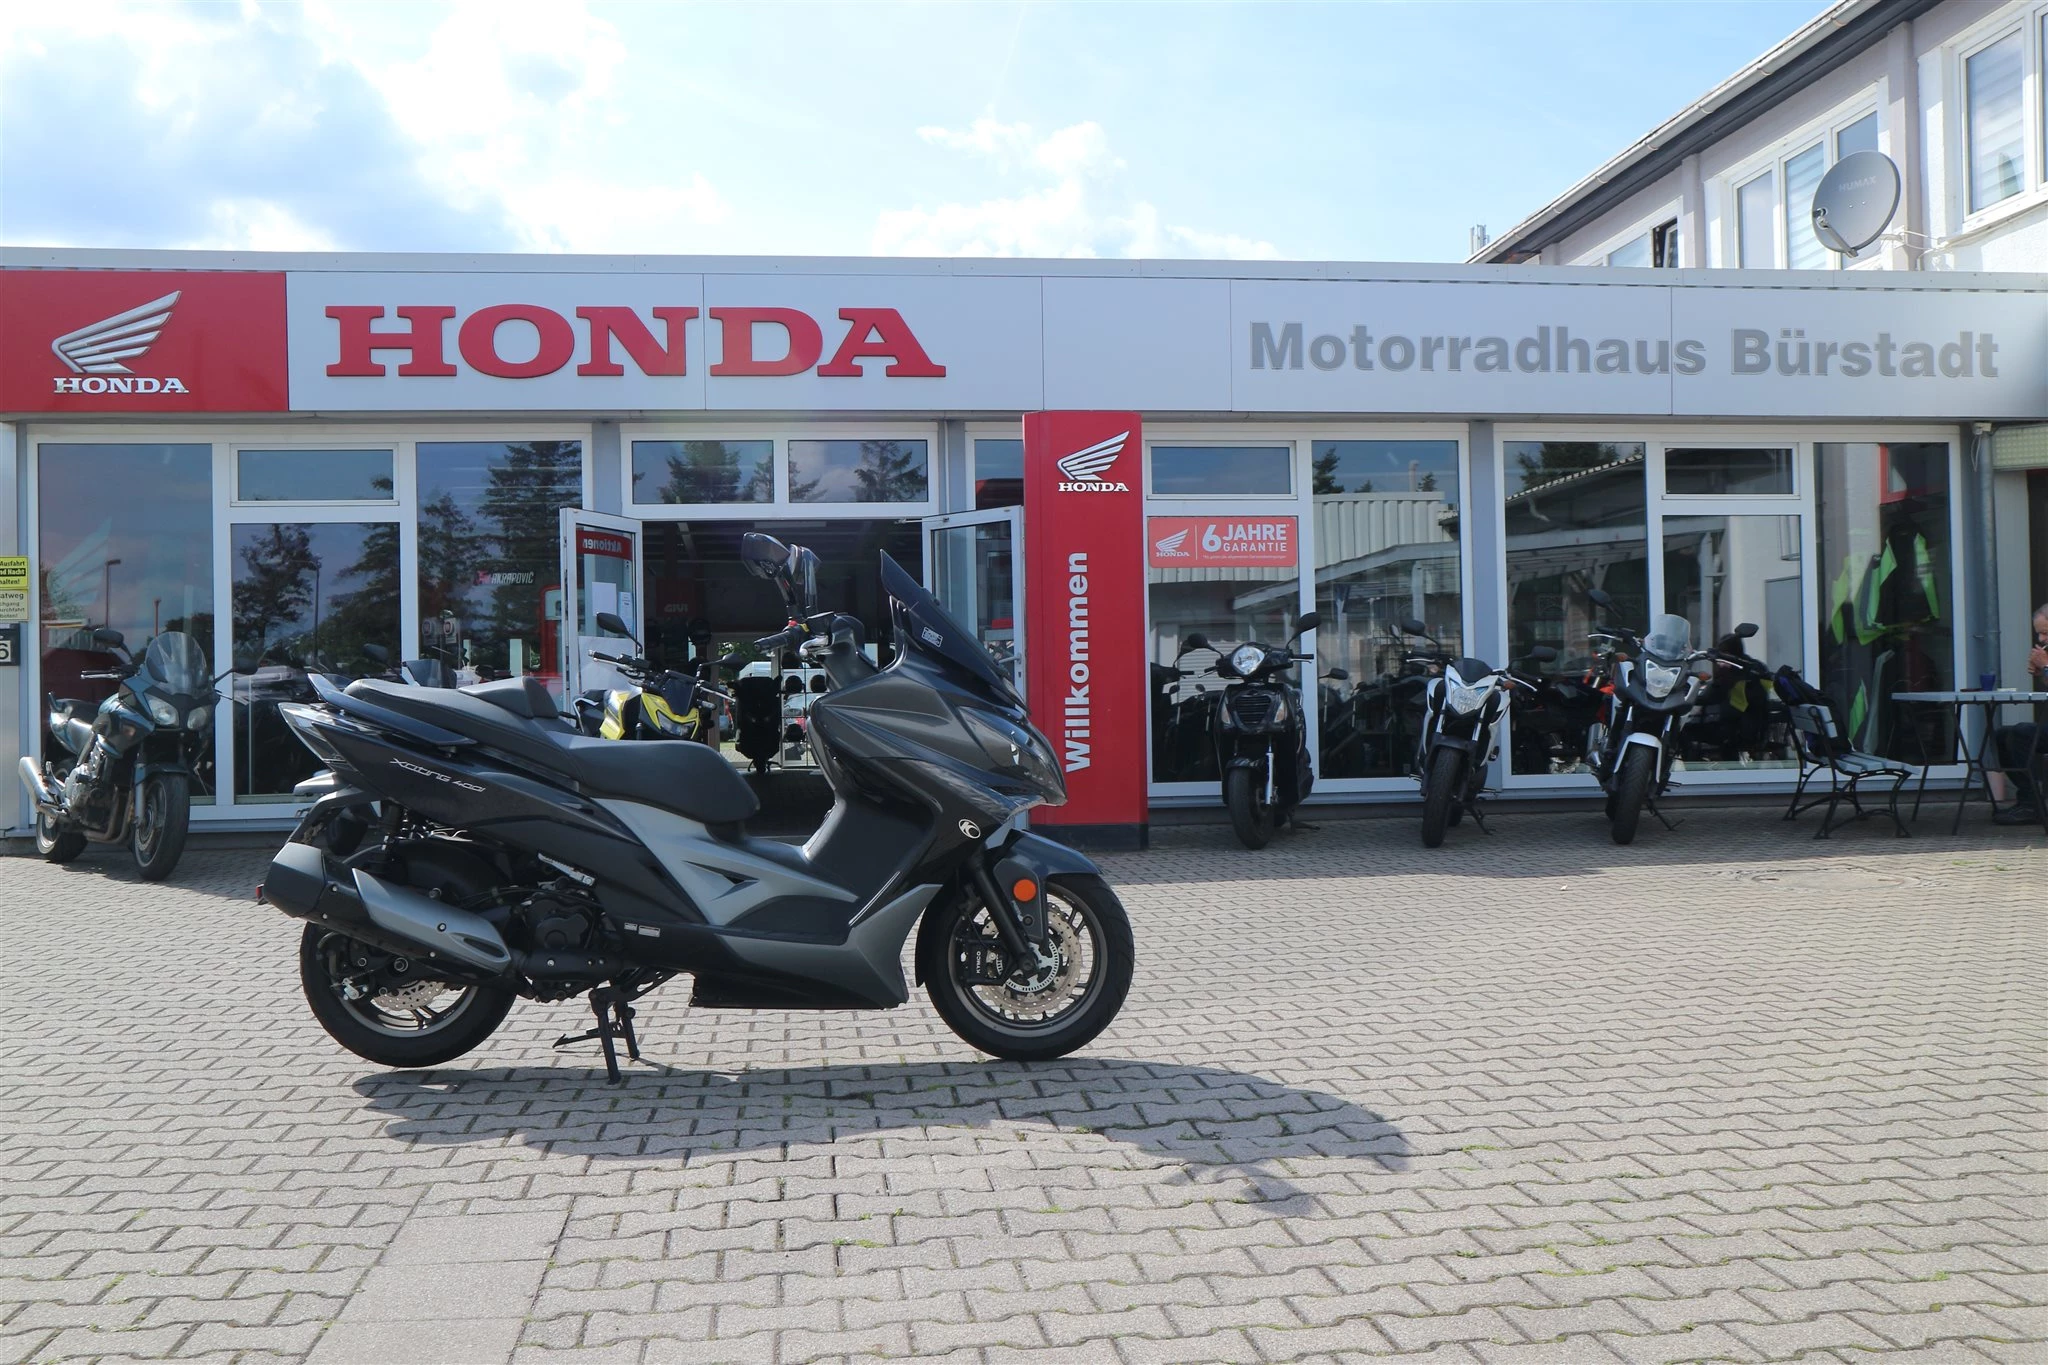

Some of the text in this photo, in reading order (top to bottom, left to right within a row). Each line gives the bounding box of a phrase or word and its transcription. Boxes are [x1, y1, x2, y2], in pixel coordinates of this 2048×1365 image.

[325, 303, 947, 379] HONDA
[1250, 321, 1999, 378] Motorradhaus Bürstadt
[53, 377, 190, 394] HONDA
[1058, 482, 1130, 492] HONDA
[1201, 524, 1222, 553] 6
[1223, 542, 1287, 552] GARANTIE
[1064, 552, 1091, 773] Willkommen
